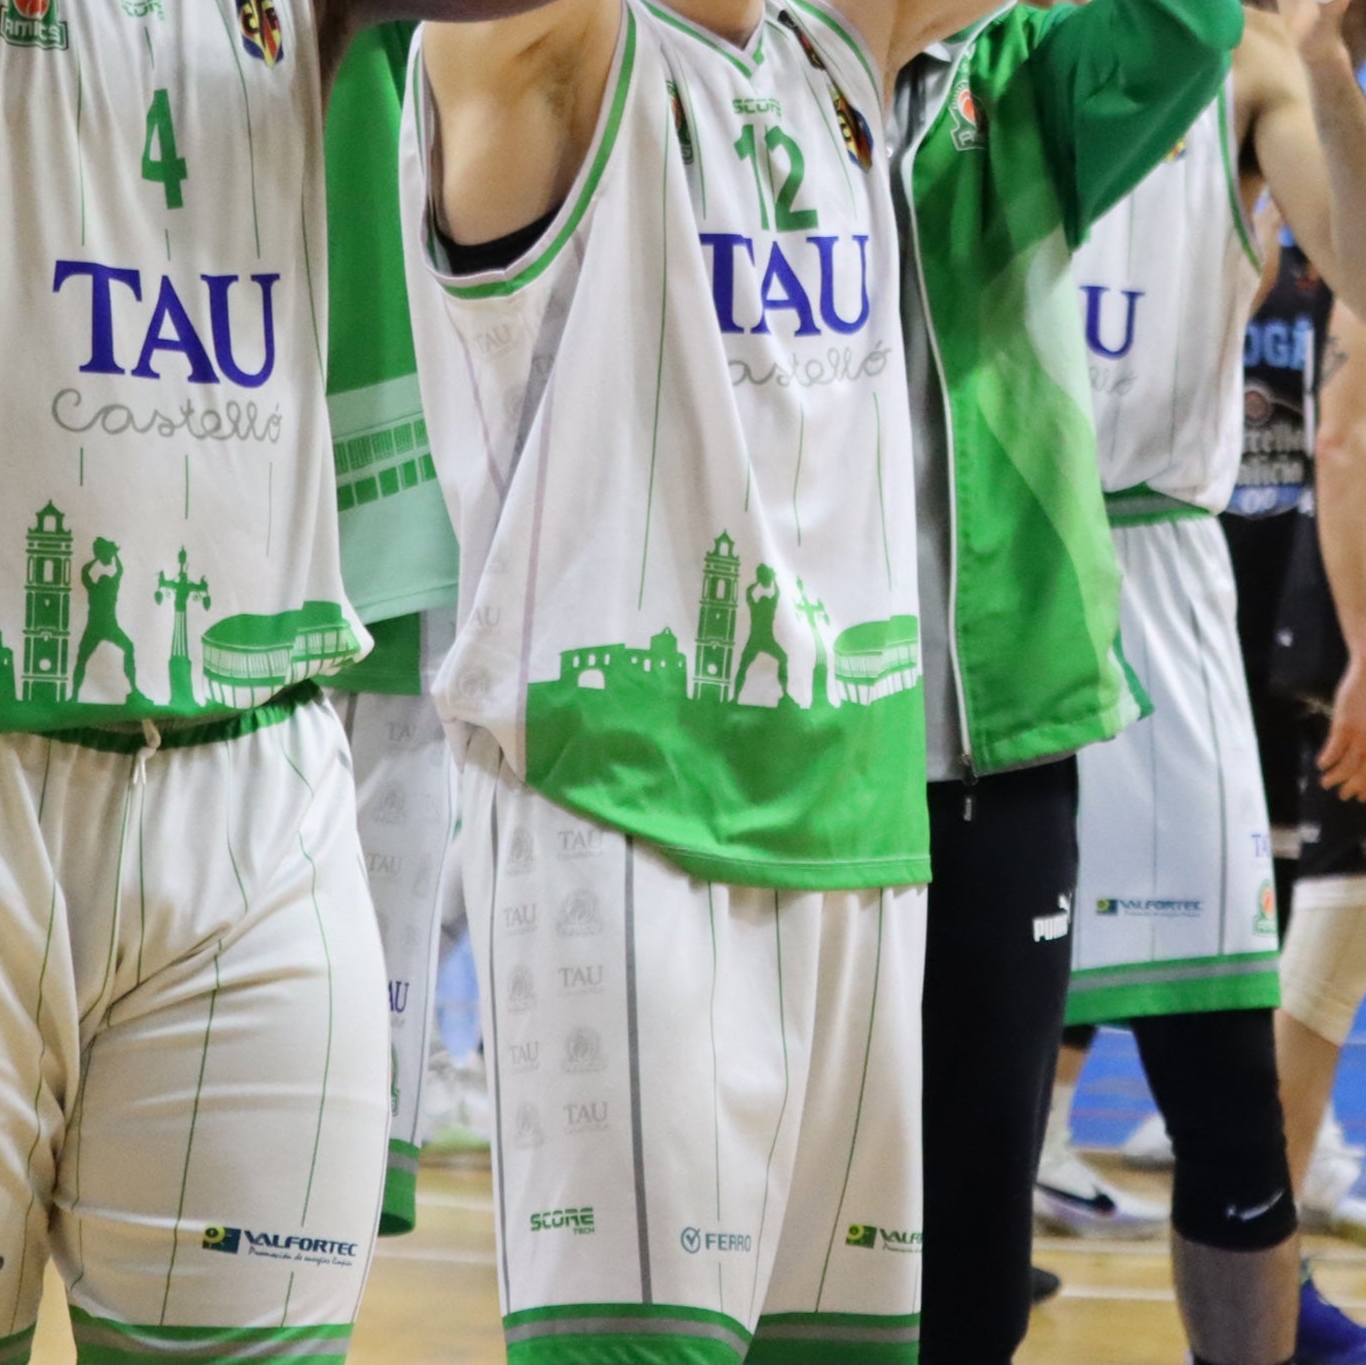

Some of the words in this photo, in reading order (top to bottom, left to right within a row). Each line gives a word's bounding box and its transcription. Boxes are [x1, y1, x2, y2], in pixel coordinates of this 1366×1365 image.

[140, 89, 189, 211] 4
[734, 123, 819, 233] 12
[699, 233, 870, 337] TAU
[52, 259, 281, 388] TAU
[727, 340, 892, 387] astelló
[50, 387, 284, 444] Castelló
[557, 829, 604, 851] TAU
[504, 903, 538, 928] TAU
[558, 965, 604, 989] TAU
[509, 1041, 540, 1065] TAU
[563, 1100, 609, 1125] TAU
[530, 1207, 596, 1232] SCORE
[244, 1229, 359, 1258] VALFORTEC
[705, 1232, 752, 1254] FERRO
